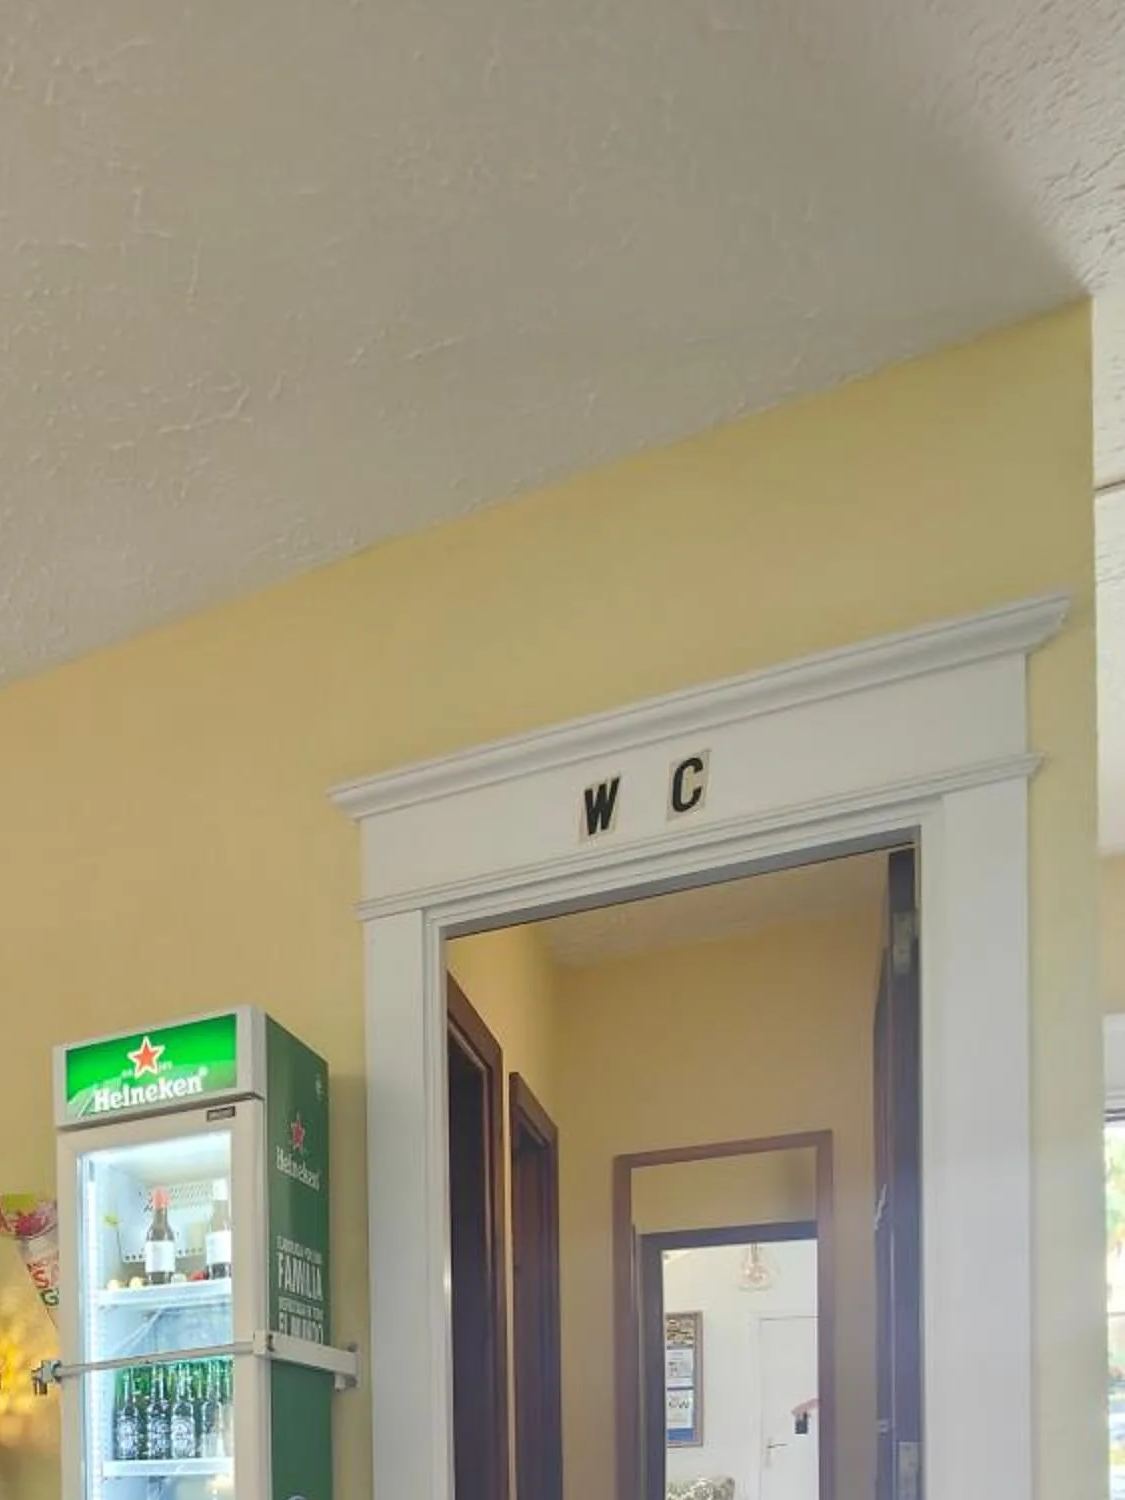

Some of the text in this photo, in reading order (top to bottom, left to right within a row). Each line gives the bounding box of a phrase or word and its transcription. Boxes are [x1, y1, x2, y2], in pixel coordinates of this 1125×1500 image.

[584, 757, 703, 836] W C
[93, 1075, 203, 1113] Heineken
